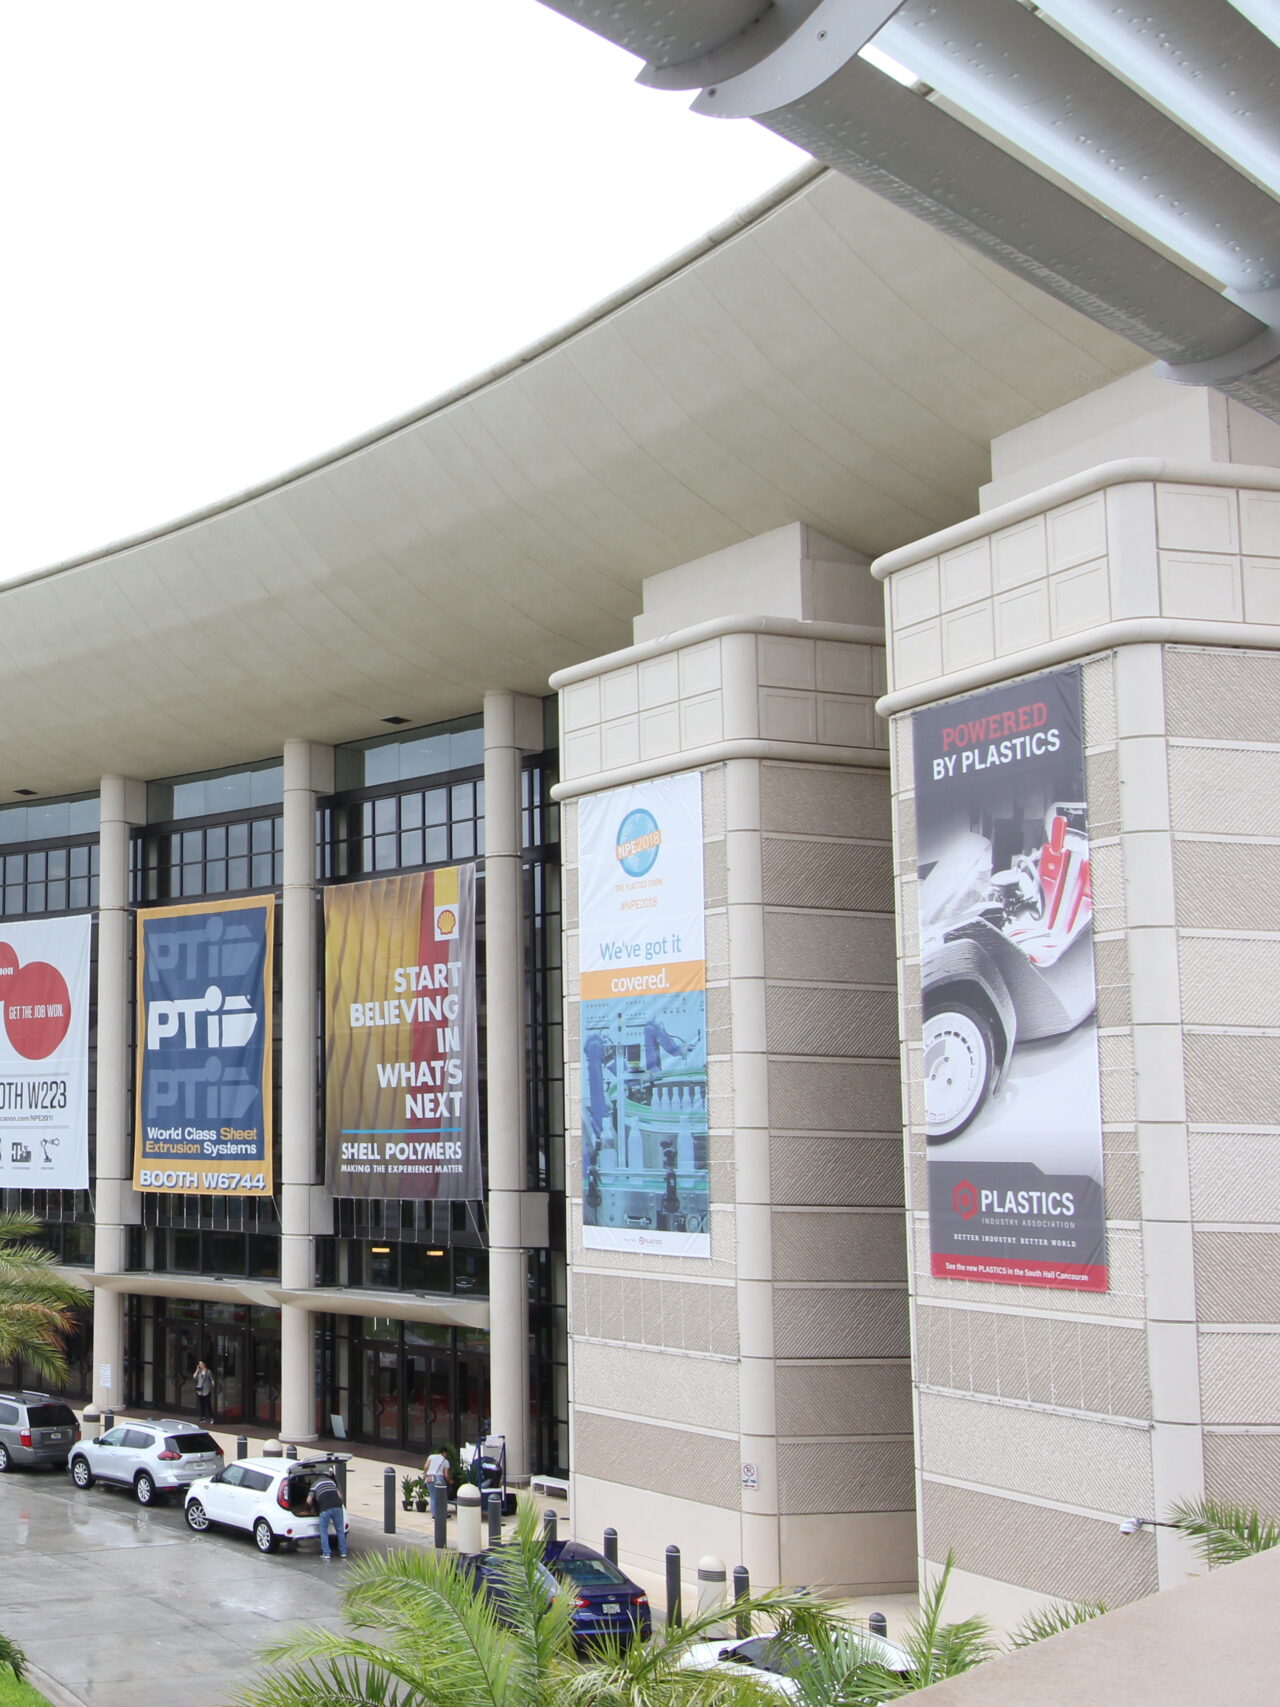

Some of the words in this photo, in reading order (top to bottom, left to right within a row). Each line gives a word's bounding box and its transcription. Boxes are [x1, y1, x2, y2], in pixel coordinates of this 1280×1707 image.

[942, 702, 1048, 752] POWERED
[933, 754, 957, 780] BY
[961, 728, 1061, 773] PLASTICS
[617, 831, 661, 859] NPE2018
[621, 896, 658, 911] #NPE2018
[599, 940, 641, 961] We've
[645, 936, 668, 960] got
[672, 934, 682, 953] it
[394, 961, 462, 993] START
[611, 968, 669, 992] covered.
[8, 1006, 21, 1020] GET
[22, 1005, 33, 1019] THE
[34, 1004, 46, 1018] JOB
[47, 1003, 64, 1017] WON.
[350, 994, 459, 1027] BELIEVING
[436, 1027, 461, 1053] IN
[377, 1058, 463, 1088] WHAT'S
[27, 1080, 67, 1110] W223
[405, 1091, 463, 1119] NEXT
[147, 1126, 182, 1140] World
[184, 1127, 217, 1140] Class
[220, 1127, 257, 1140] Sheet
[145, 1140, 200, 1153] Extrusion
[203, 1141, 257, 1157] Systems
[341, 1142, 380, 1160] SHELL
[385, 1141, 462, 1160] POLYMERS
[140, 1169, 198, 1188] BOOTH
[202, 1172, 266, 1190] W6744
[341, 1164, 371, 1173] MAKING
[373, 1165, 386, 1173] THE
[388, 1164, 433, 1174] EXPERIENCE
[434, 1164, 463, 1174] MATTER
[981, 1189, 1075, 1216] PLASTICS
[981, 1217, 1019, 1226] INDUSTRY
[1021, 1219, 1076, 1229] ASSOCIATION
[953, 1233, 980, 1241] BETTER
[1020, 1237, 1049, 1246] BETTER
[945, 1262, 956, 1270] See
[956, 1263, 966, 1271] the
[978, 1264, 1007, 1275] PLASTICS
[1007, 1267, 1014, 1275] in
[1014, 1268, 1024, 1276] the
[1024, 1269, 1042, 1278] South
[1042, 1270, 1055, 1279] Hall
[1055, 1271, 1089, 1282] Concourse
